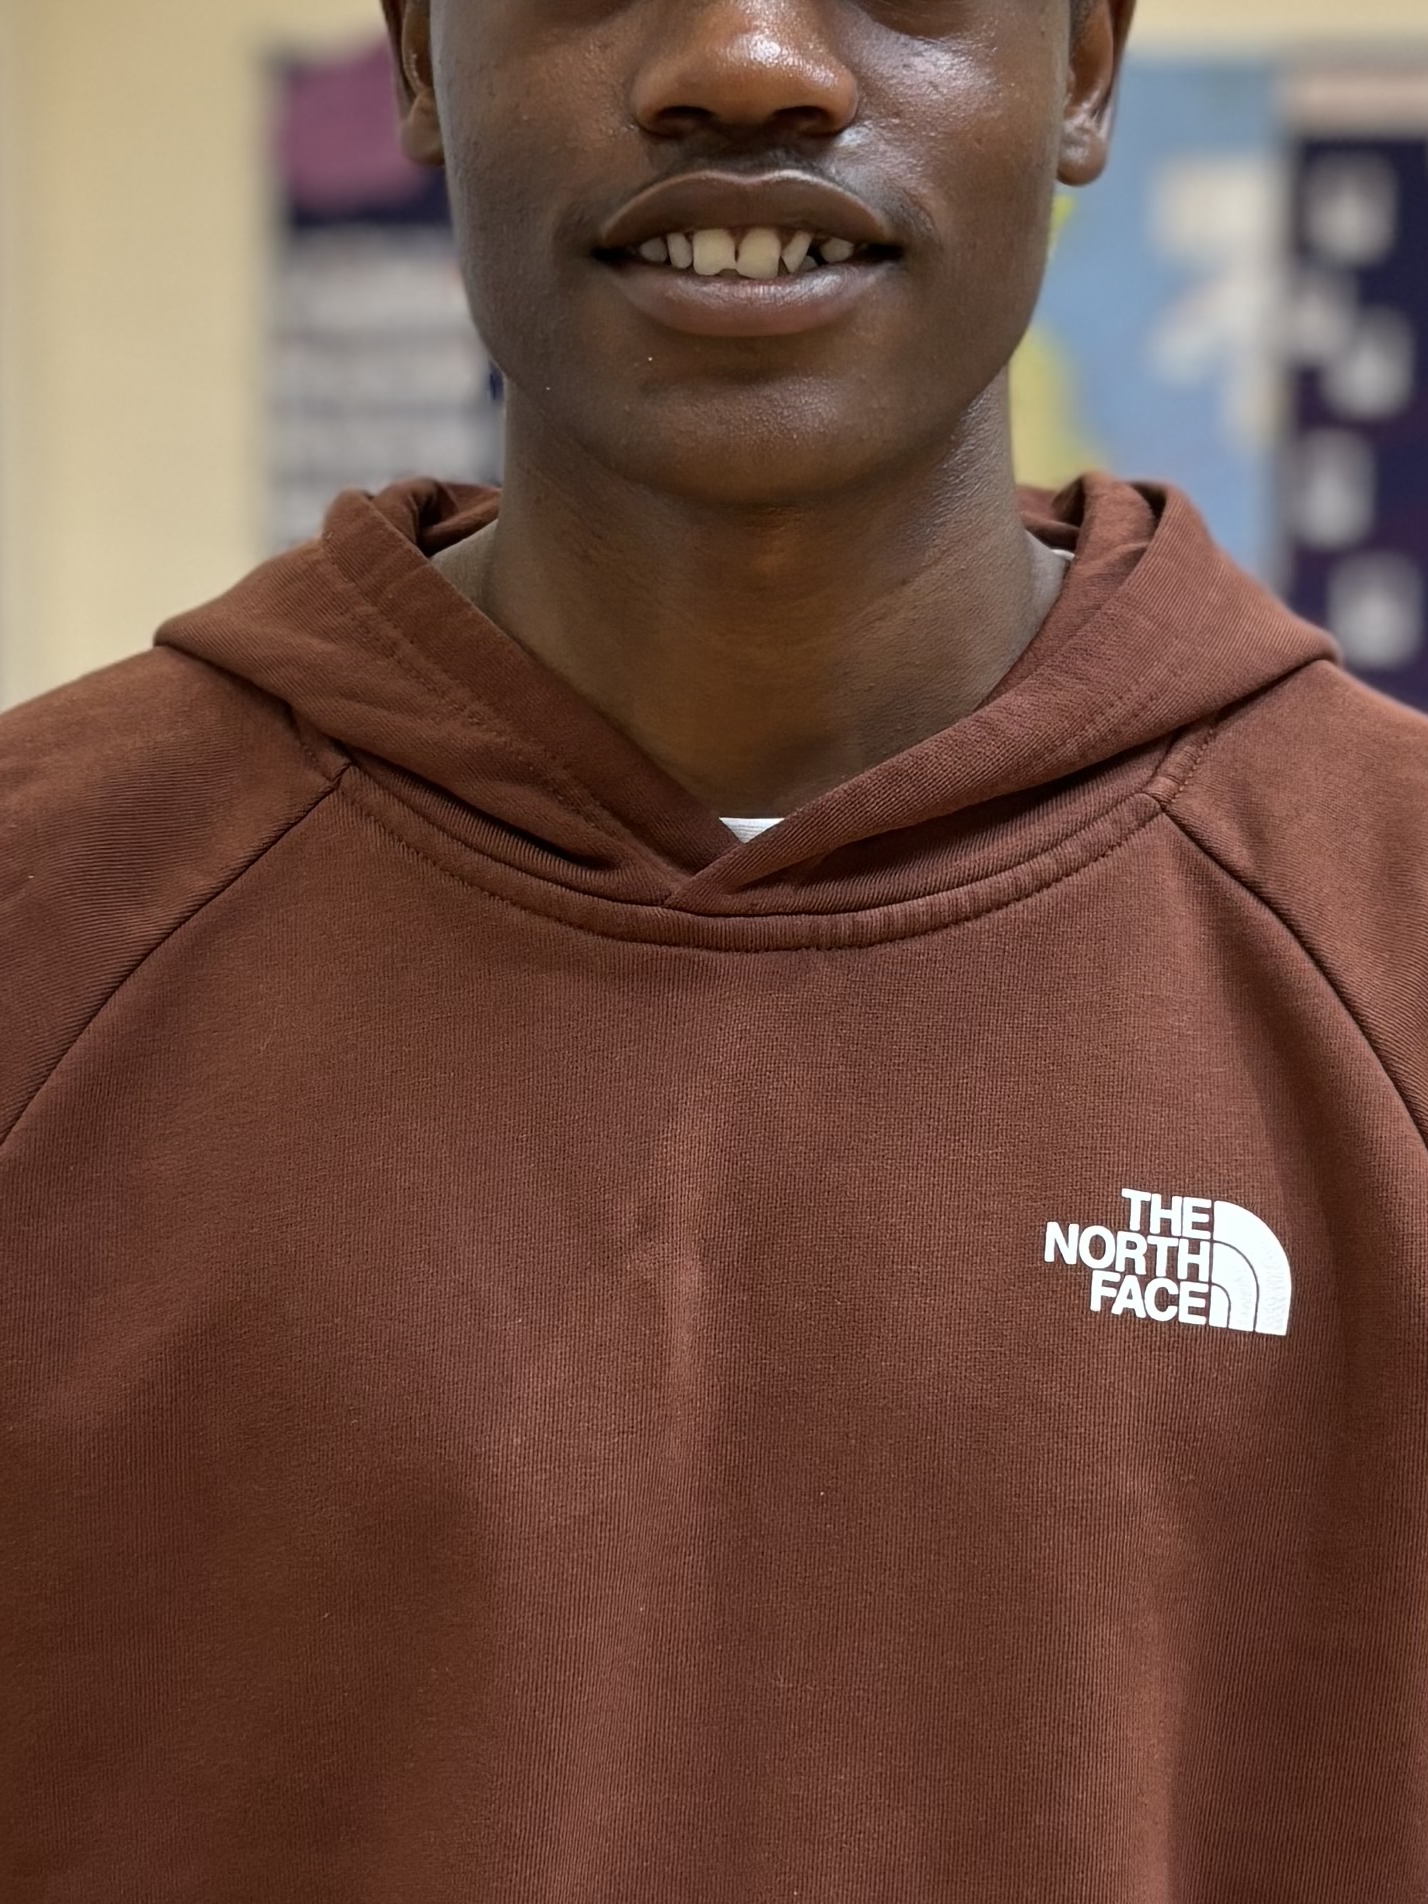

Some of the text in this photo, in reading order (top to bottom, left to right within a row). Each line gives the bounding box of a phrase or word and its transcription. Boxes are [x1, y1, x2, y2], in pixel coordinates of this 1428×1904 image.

[1121, 1188, 1212, 1239] THE
[1043, 1221, 1211, 1282] NORTH
[1089, 1269, 1209, 1326] FACE
